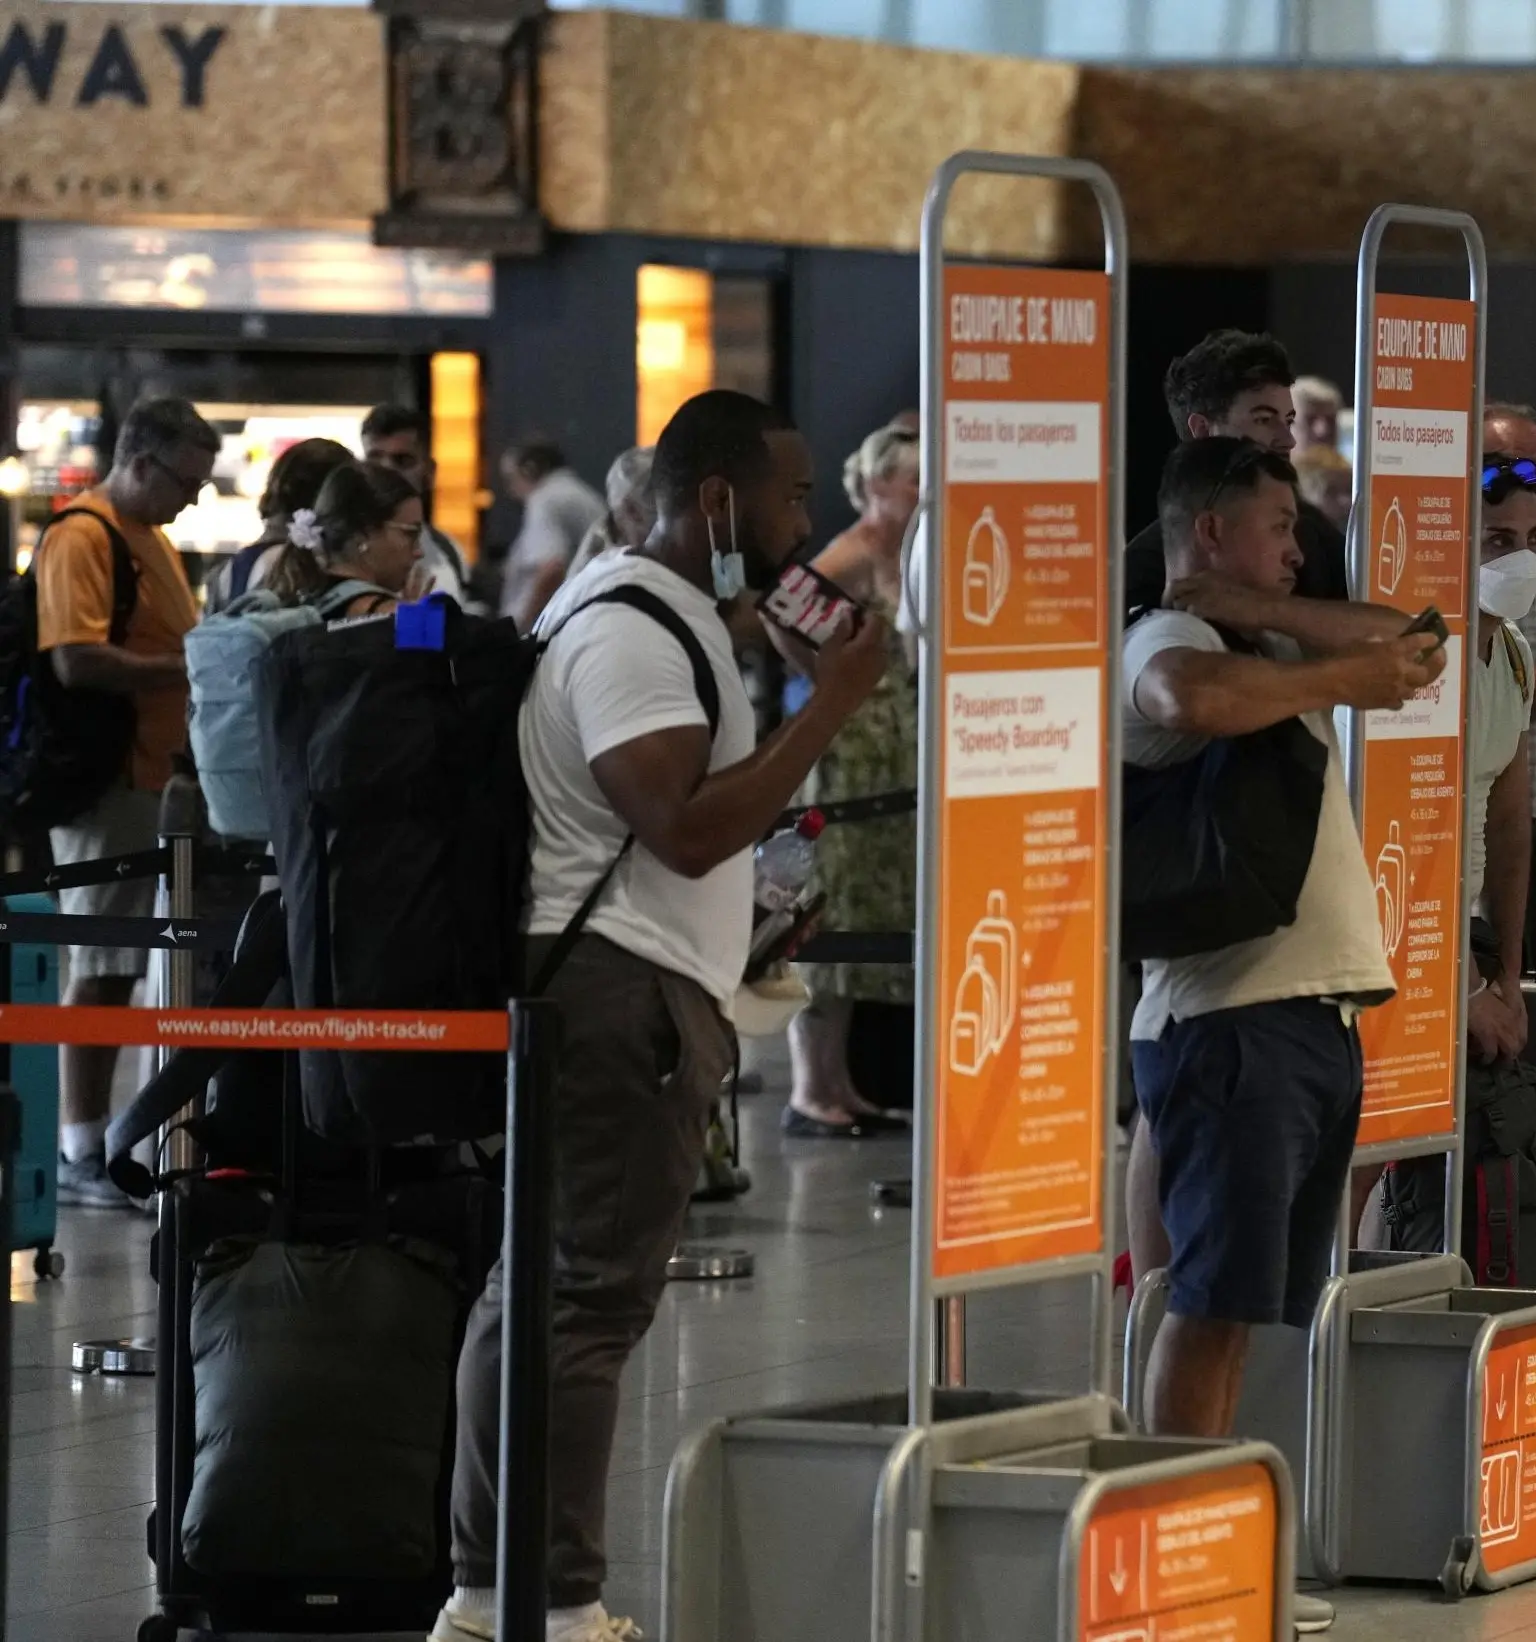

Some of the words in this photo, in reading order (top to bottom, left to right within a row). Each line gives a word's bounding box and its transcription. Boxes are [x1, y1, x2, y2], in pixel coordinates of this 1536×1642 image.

[951, 294, 1024, 343] EQUIPAJE
[1028, 297, 1049, 343] DE
[1051, 298, 1098, 346] MANO
[1377, 317, 1423, 359] EQUIPAJE
[1425, 321, 1438, 360] DE
[1440, 322, 1467, 361] MANO
[953, 415, 993, 443] Todos
[996, 416, 1015, 443] los
[1018, 417, 1077, 449] pasajeros
[1376, 419, 1401, 442] Todos
[1403, 420, 1415, 443] los
[1416, 422, 1454, 447] pasajeros
[953, 692, 1018, 720] Pasajeros
[1021, 695, 1046, 714] con
[177, 928, 197, 938] aena
[157, 1016, 446, 1041] www.easyJet.com/flight-tracker
